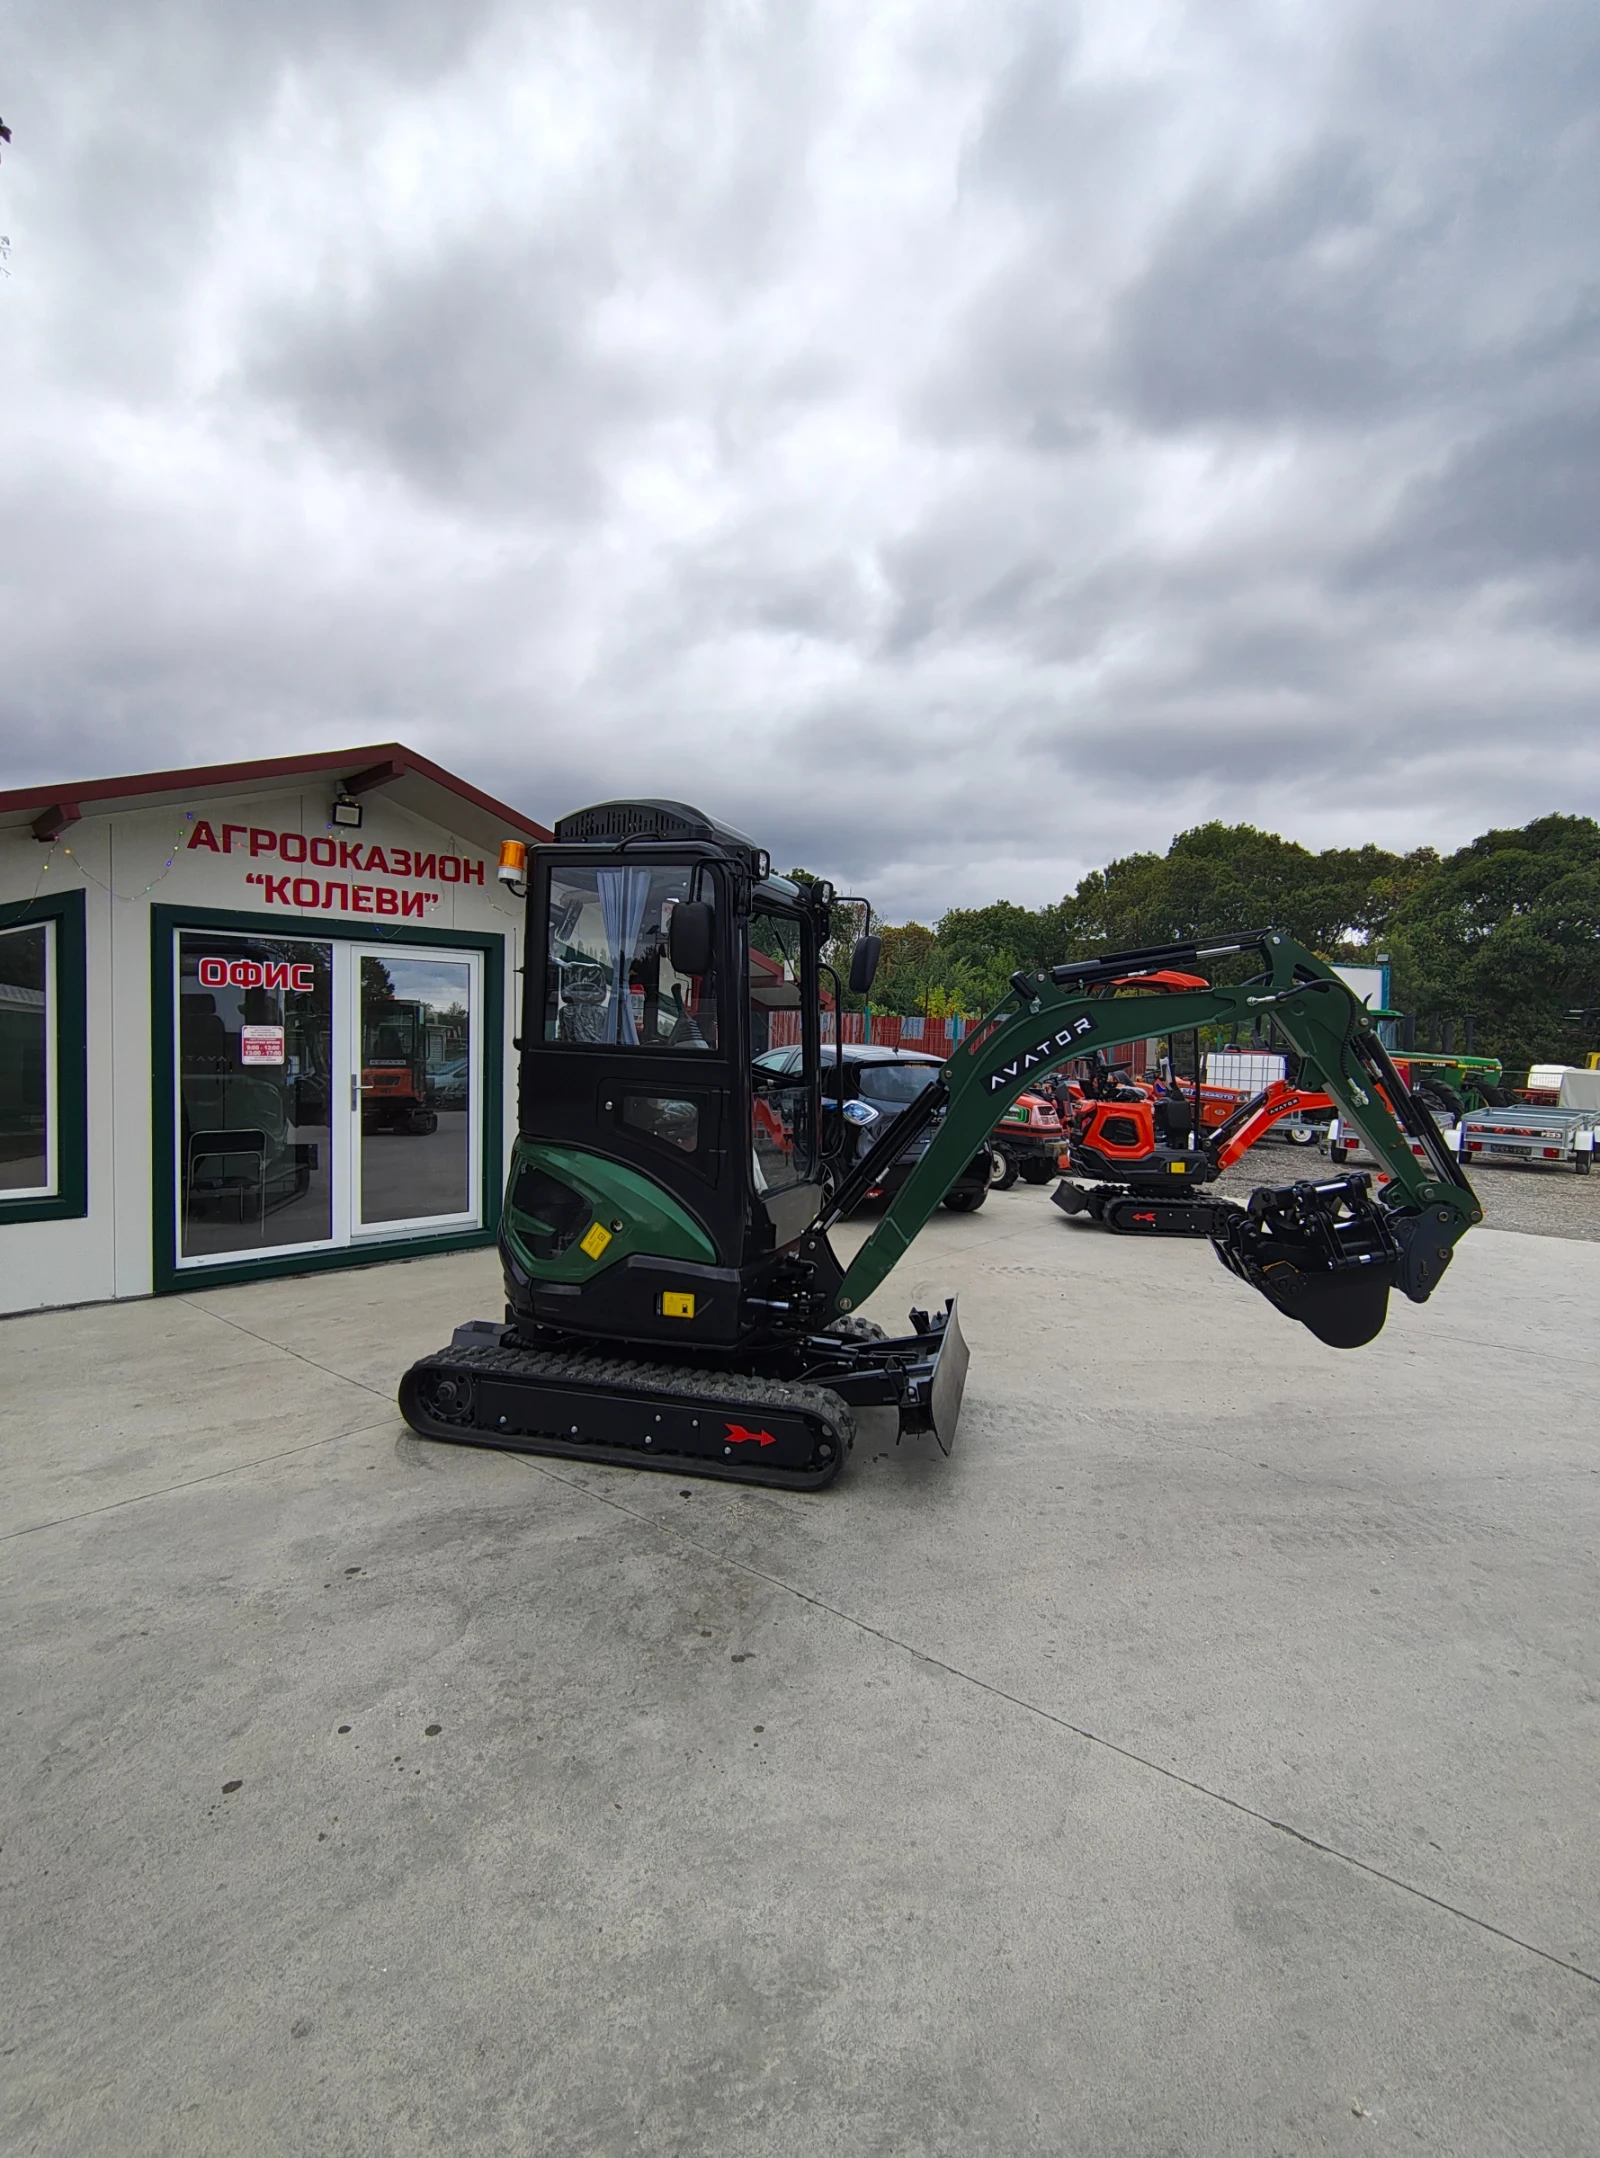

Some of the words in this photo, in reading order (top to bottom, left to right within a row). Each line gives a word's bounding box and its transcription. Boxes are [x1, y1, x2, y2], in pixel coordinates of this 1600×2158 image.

[186, 820, 485, 885] АГРООКАЗИОН
[199, 957, 314, 991] ОФИС
[991, 1017, 1092, 1090] AVATOR
[1269, 1098, 1298, 1114] AVATOR
